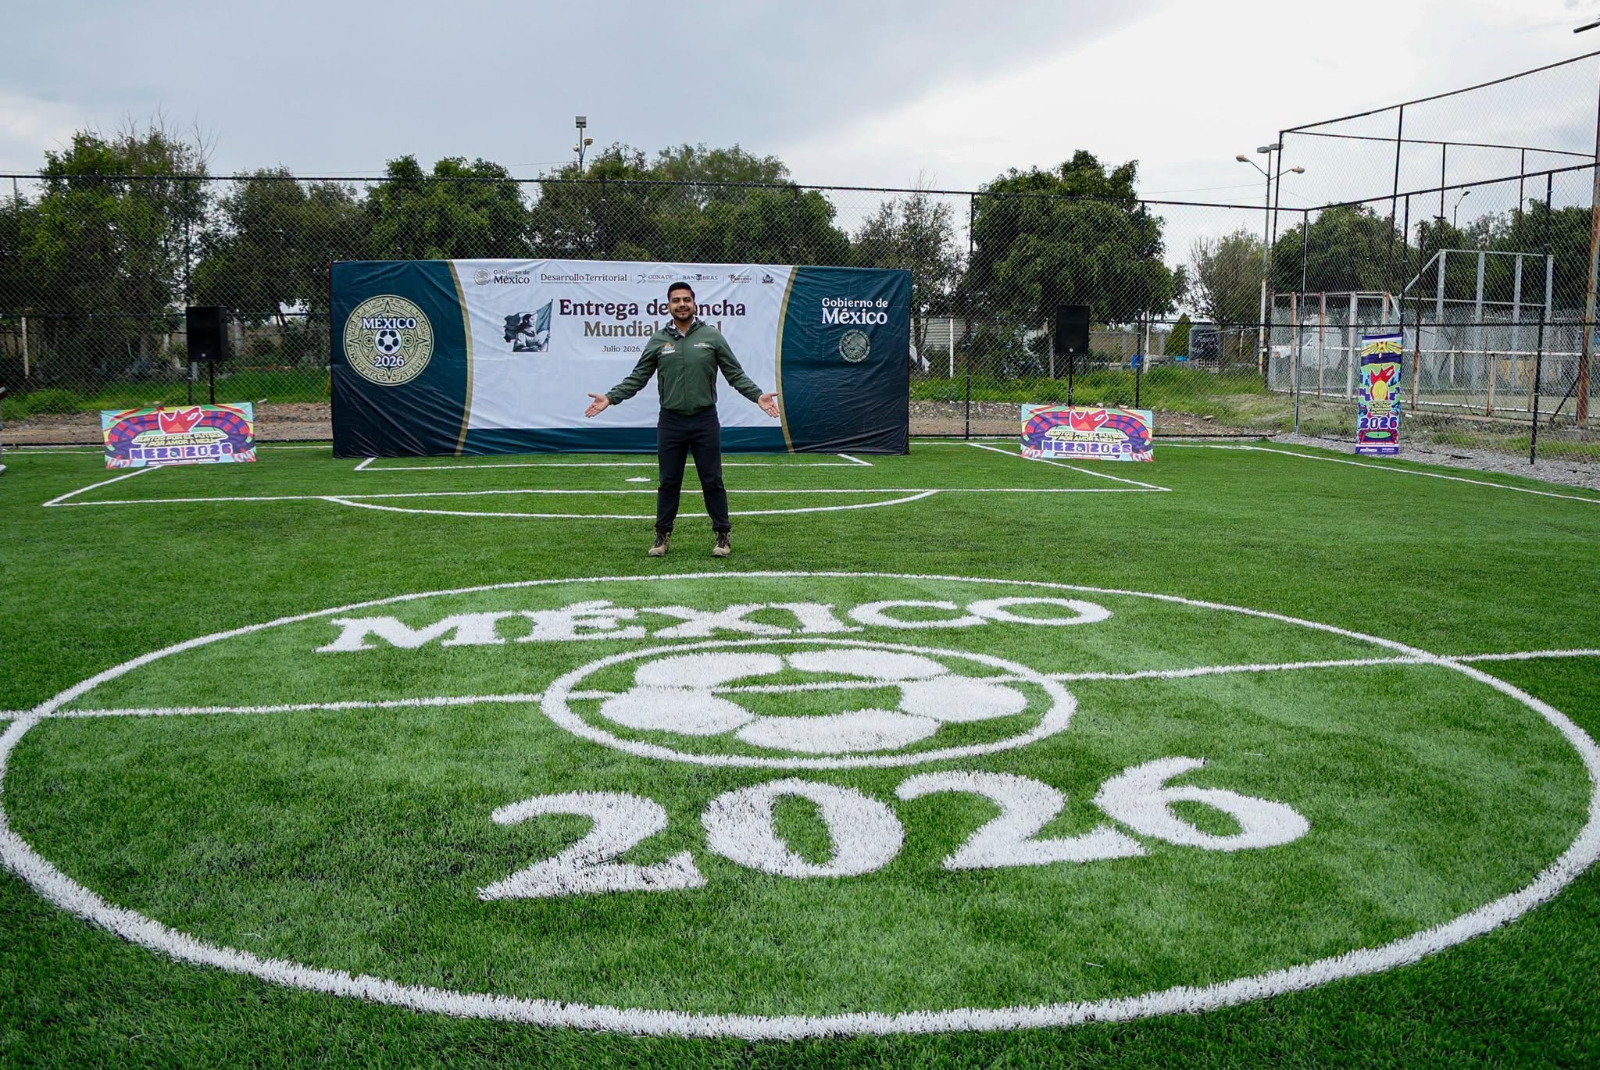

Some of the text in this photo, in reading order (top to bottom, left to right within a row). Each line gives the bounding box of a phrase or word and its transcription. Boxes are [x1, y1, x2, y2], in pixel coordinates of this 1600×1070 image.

[493, 274, 530, 284] México
[541, 273, 628, 282] Desarrollo Territorial
[559, 298, 639, 320] Entrega
[646, 298, 669, 316] de
[821, 297, 889, 308] Gobierno de
[363, 316, 416, 329] MÉXICO
[821, 307, 888, 325] México
[583, 320, 660, 337] Mundial
[601, 345, 621, 353] Julio
[375, 356, 404, 367] 2026
[1360, 416, 1398, 429] 2026
[312, 598, 1112, 653] MÉXICO
[478, 757, 1310, 902] 2026
